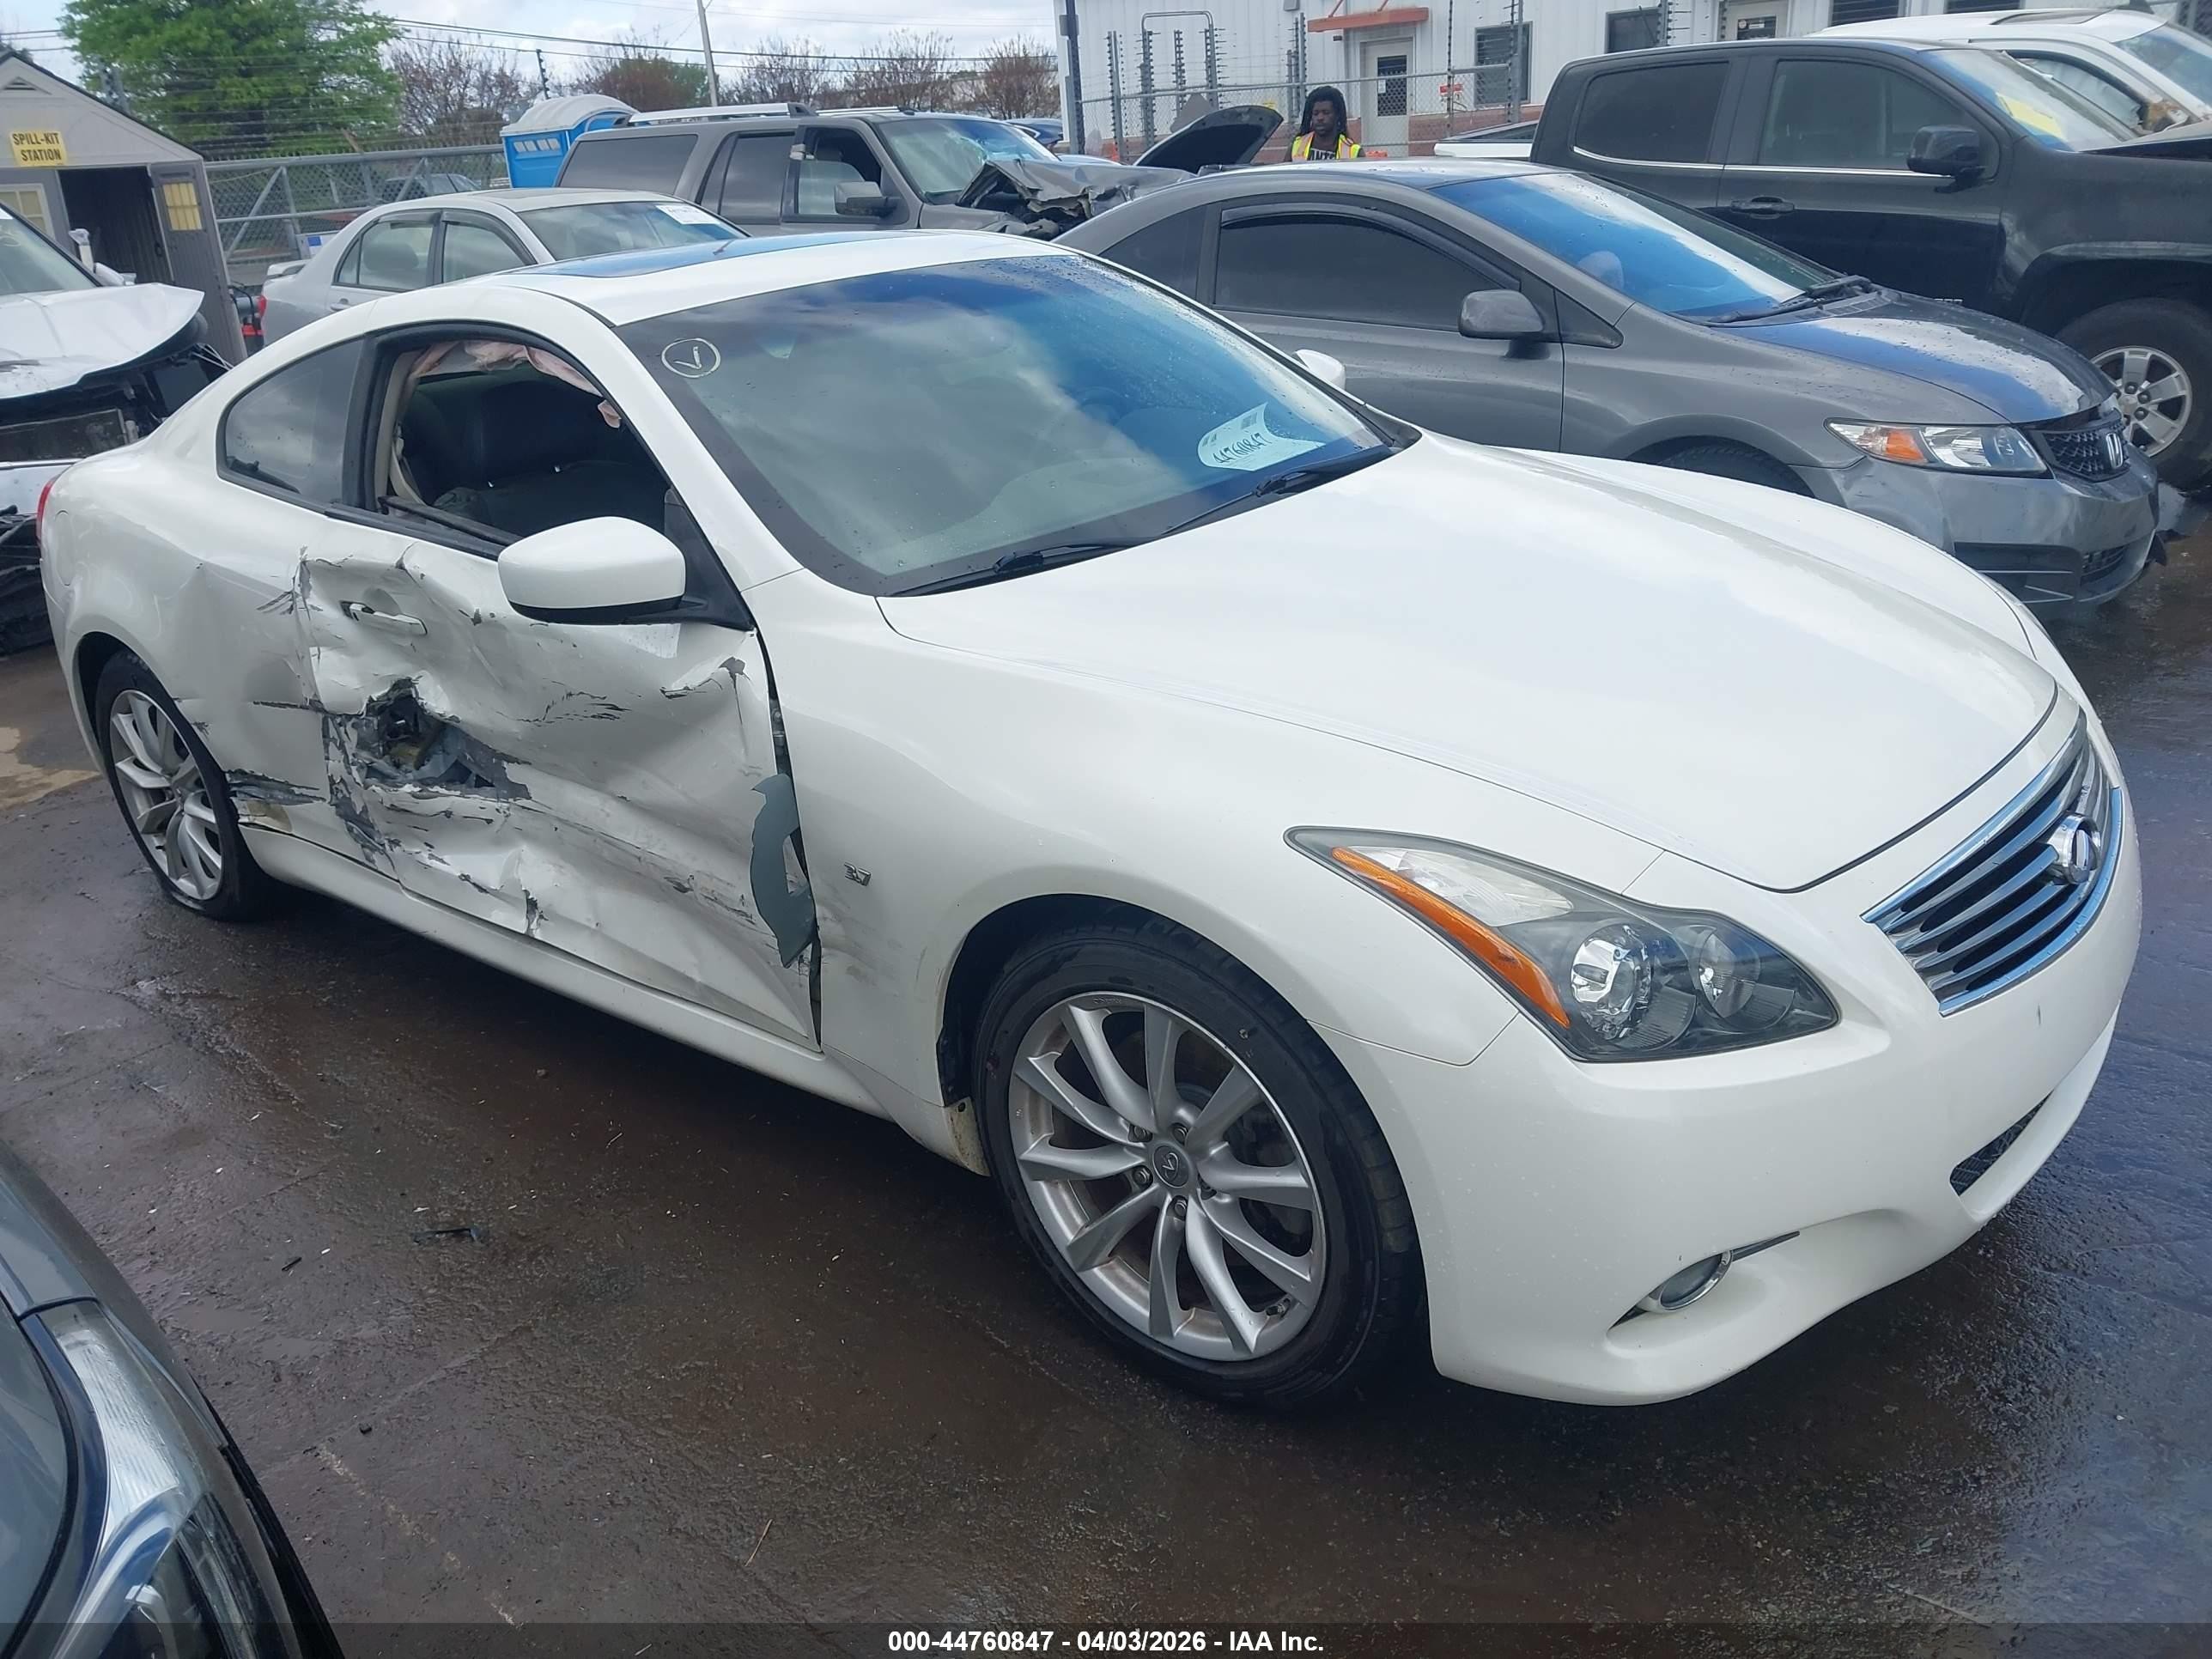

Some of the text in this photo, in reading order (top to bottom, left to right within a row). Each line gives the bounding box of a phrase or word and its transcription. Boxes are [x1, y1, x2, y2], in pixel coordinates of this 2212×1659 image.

[12, 132, 60, 145] SPILL-KIT
[20, 149, 62, 161] STATION
[1212, 432, 1273, 464] 44760847
